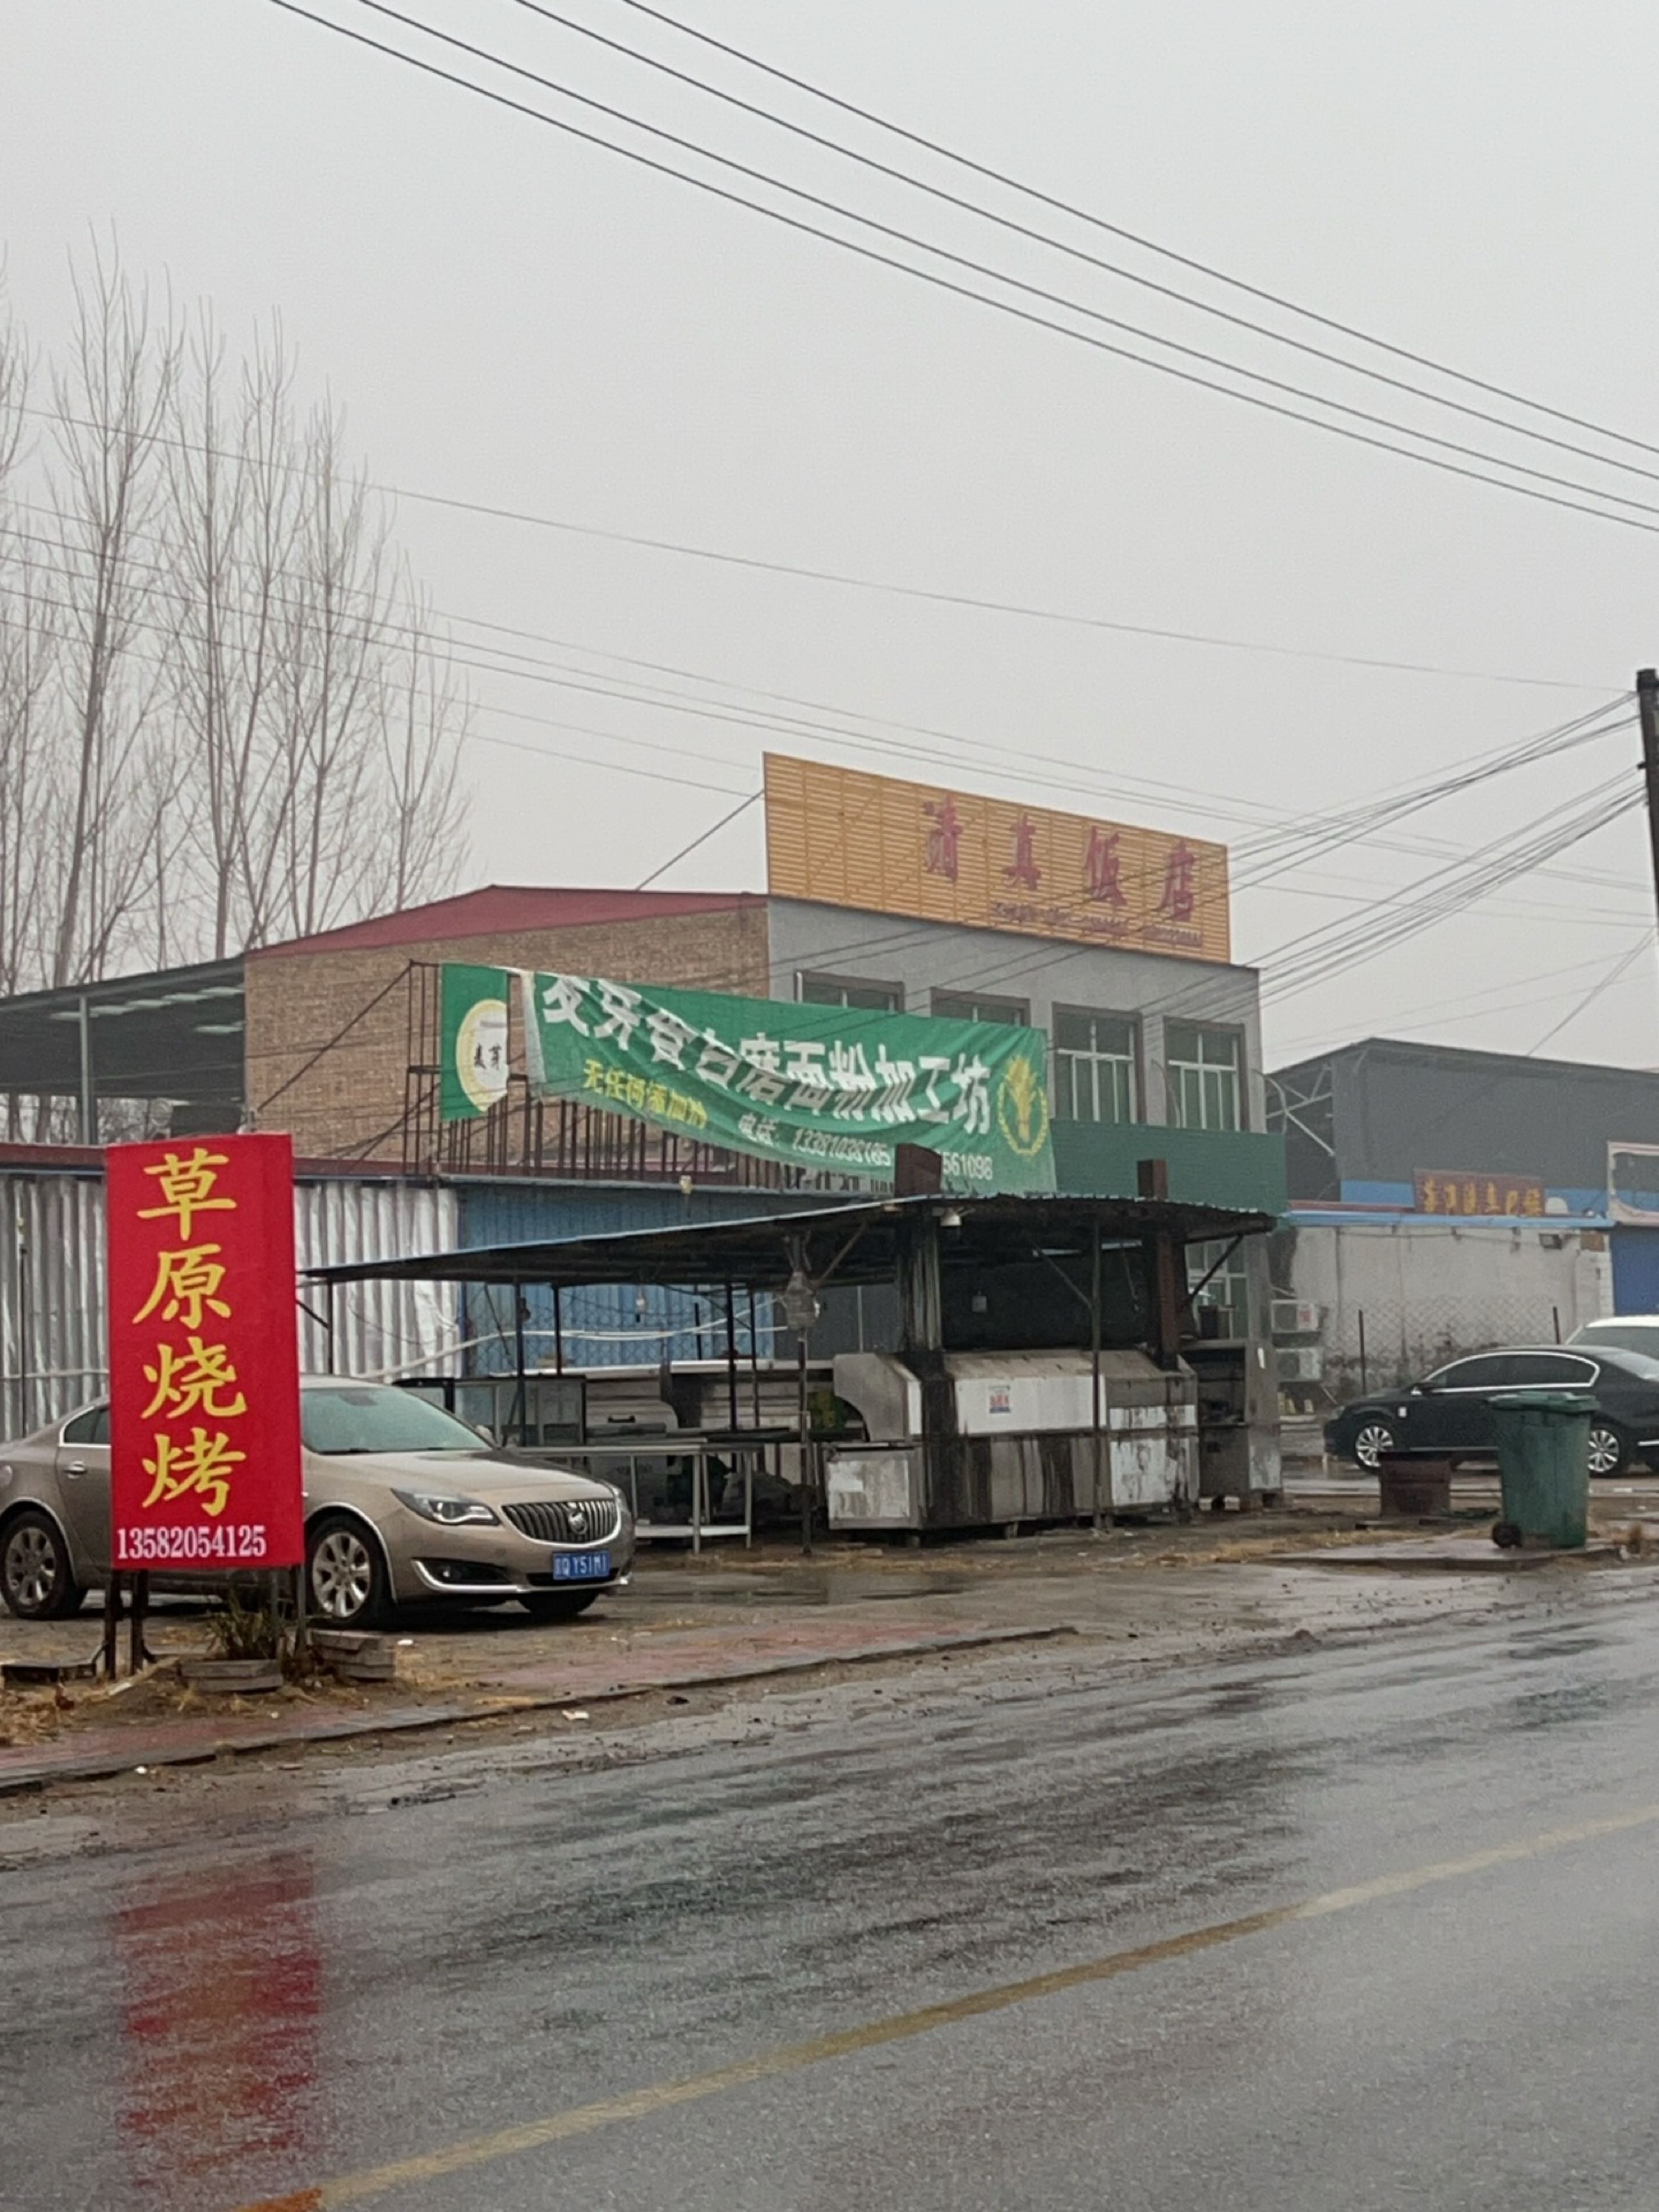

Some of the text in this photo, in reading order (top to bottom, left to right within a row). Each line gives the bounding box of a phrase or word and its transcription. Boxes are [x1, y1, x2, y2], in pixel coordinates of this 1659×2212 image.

[132, 1147, 248, 1516] 草原烧烤
[116, 1525, 266, 1560] 13582054125
